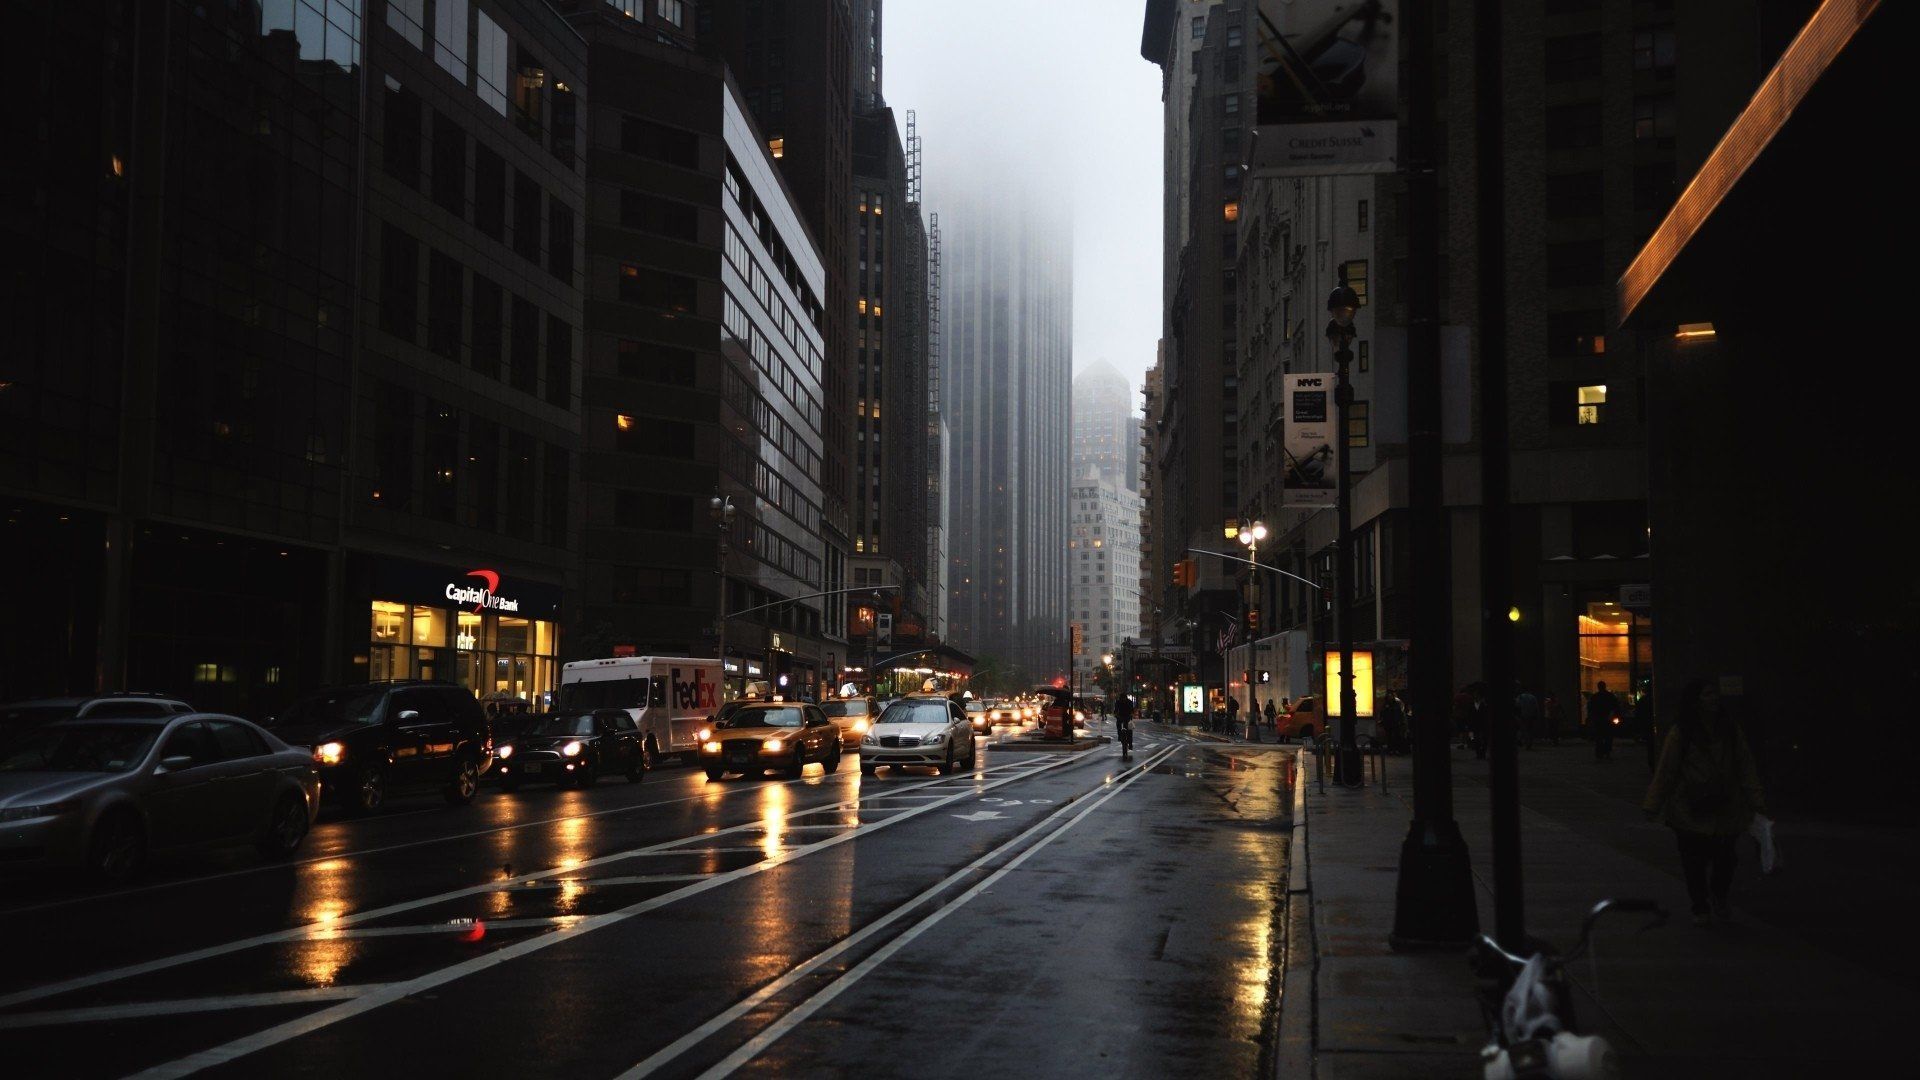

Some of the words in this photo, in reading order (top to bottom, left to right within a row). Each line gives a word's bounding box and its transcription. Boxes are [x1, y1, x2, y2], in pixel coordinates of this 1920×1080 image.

[1297, 378, 1322, 387] NYC
[499, 597, 519, 612] Bank
[671, 668, 717, 710] FedEx
